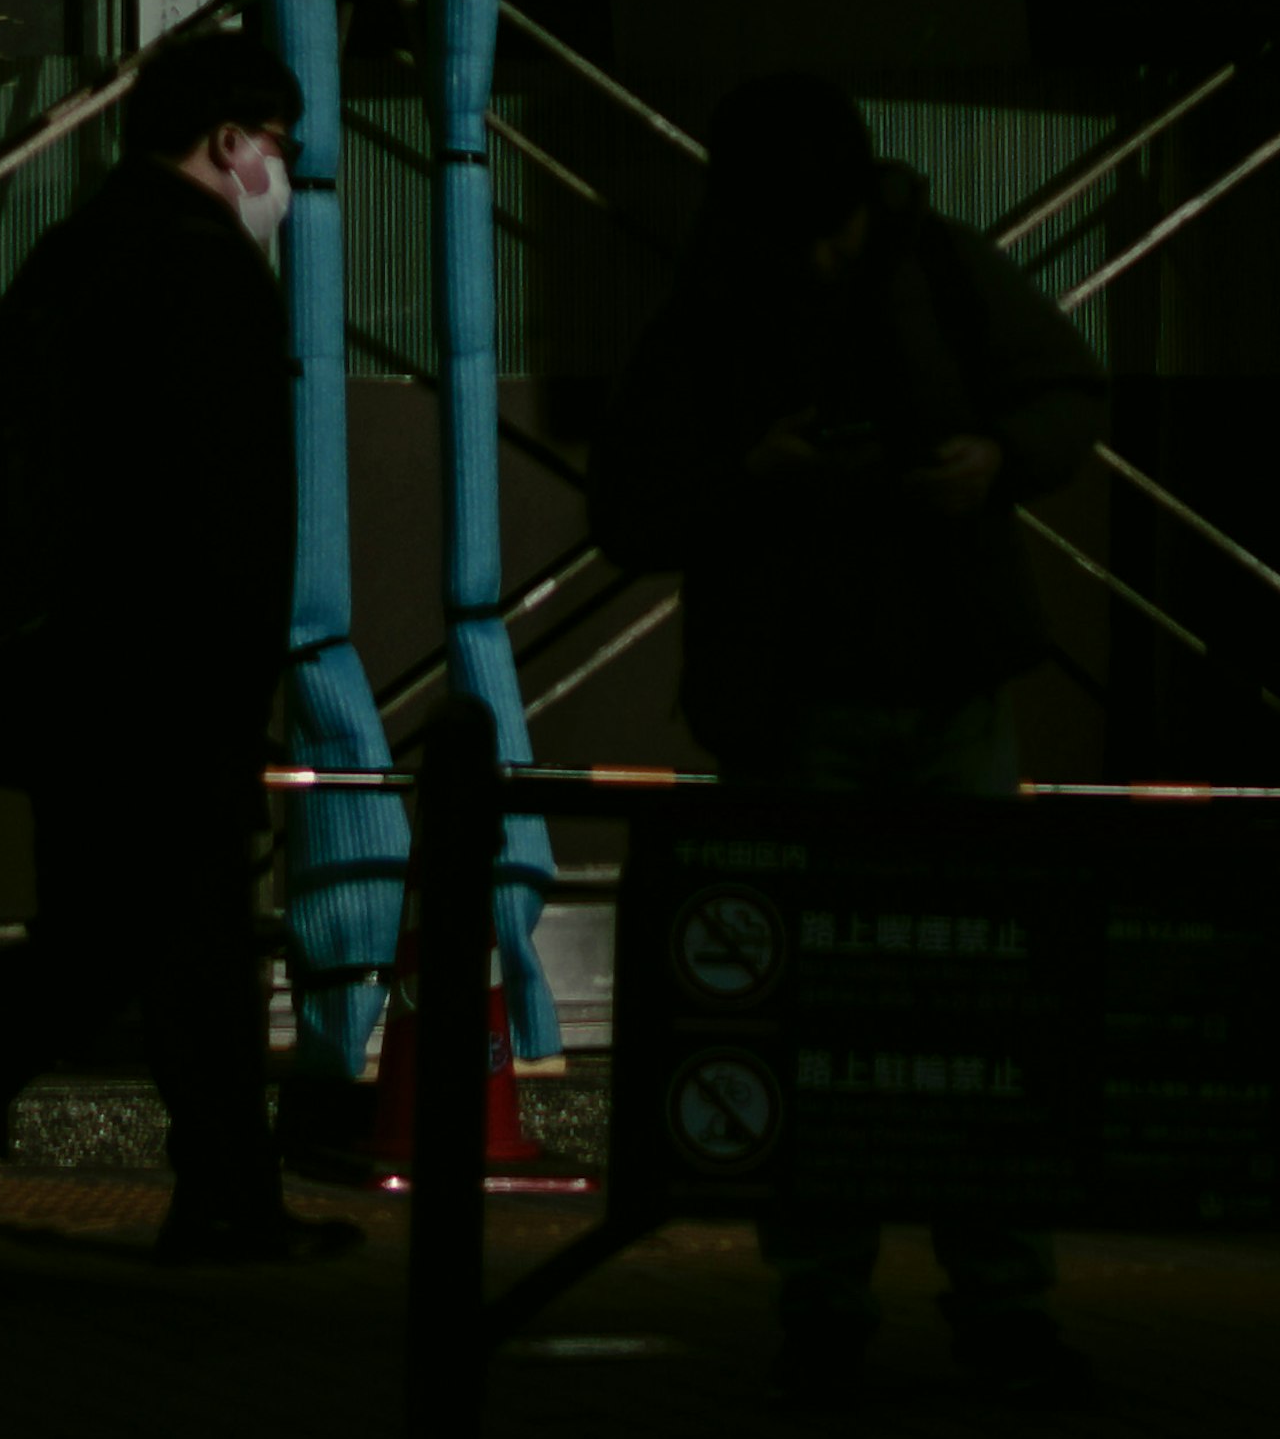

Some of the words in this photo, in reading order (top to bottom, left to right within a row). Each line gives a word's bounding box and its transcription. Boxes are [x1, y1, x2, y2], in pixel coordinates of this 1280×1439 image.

[799, 909, 1029, 958] 路上喫煙禁止
